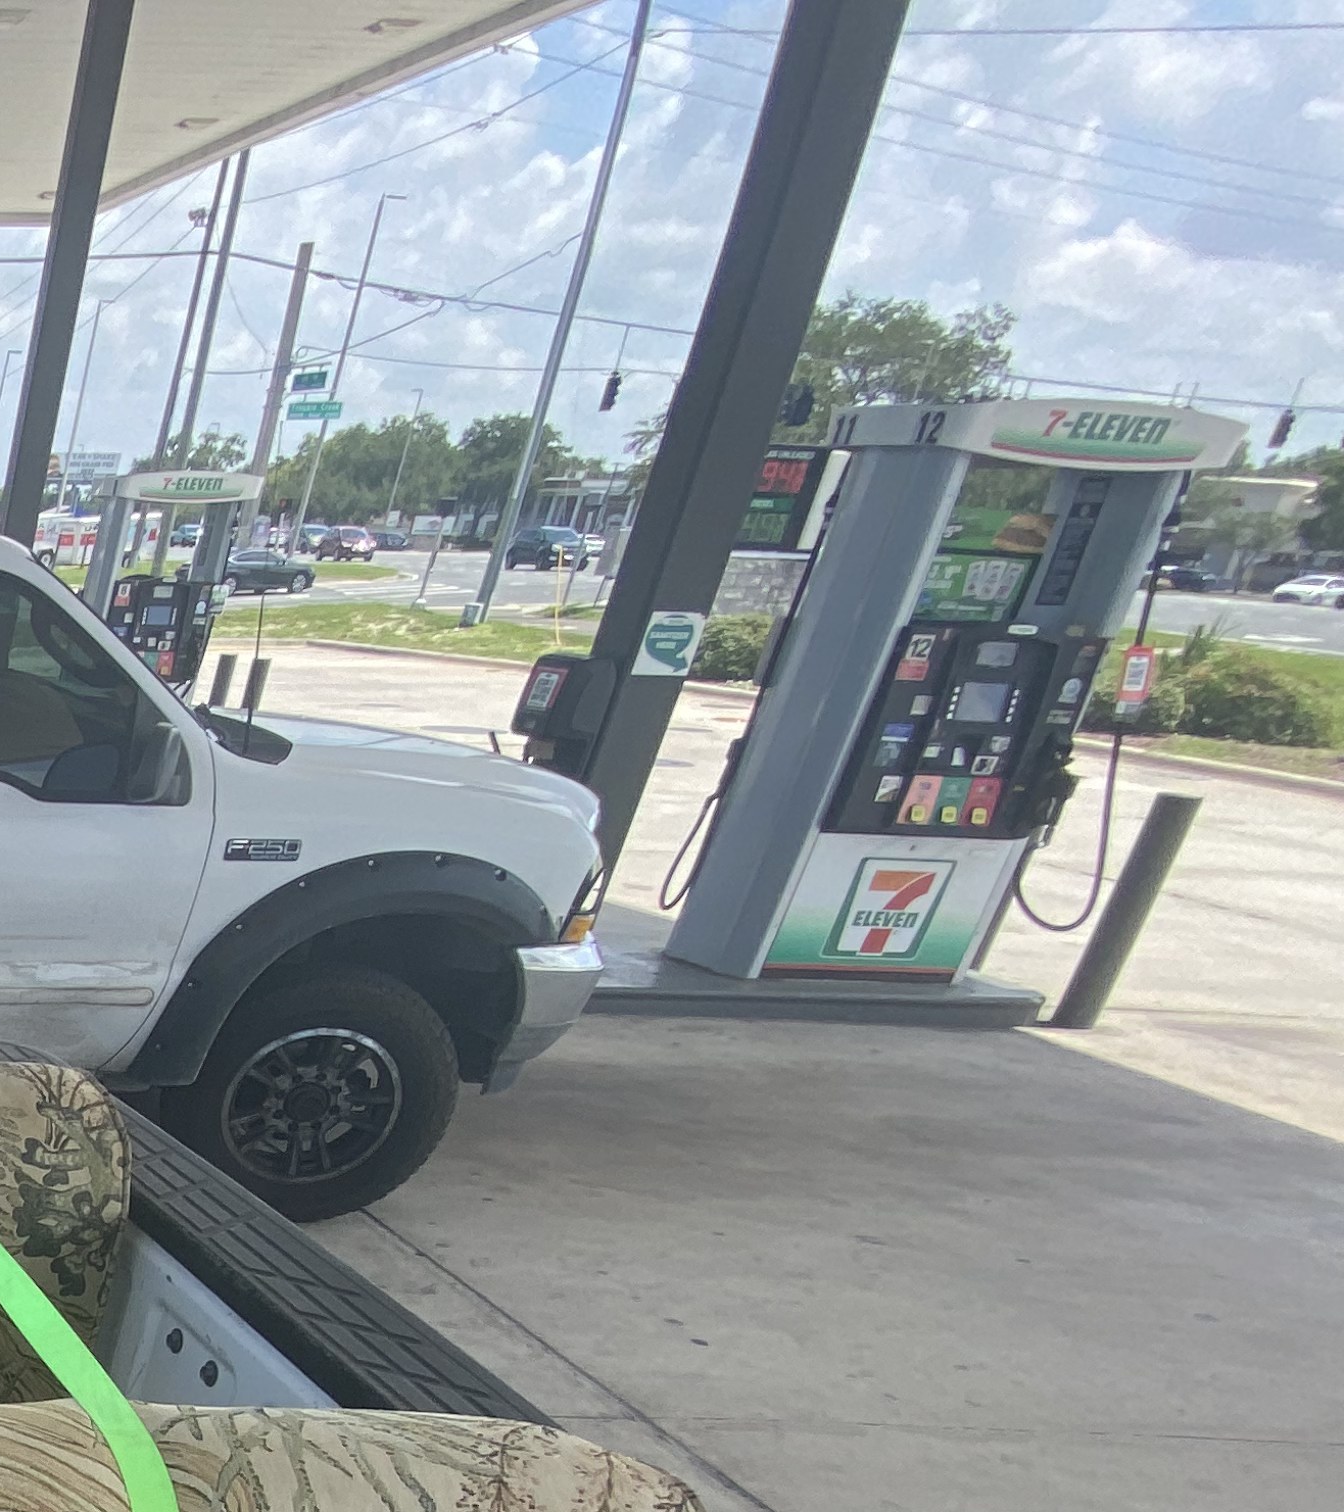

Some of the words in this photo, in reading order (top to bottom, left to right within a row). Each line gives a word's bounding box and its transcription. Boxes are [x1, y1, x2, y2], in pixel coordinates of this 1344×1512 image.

[831, 414, 859, 446] 11
[915, 411, 946, 443] 12
[910, 637, 933, 658] 12
[858, 869, 937, 954] 7
